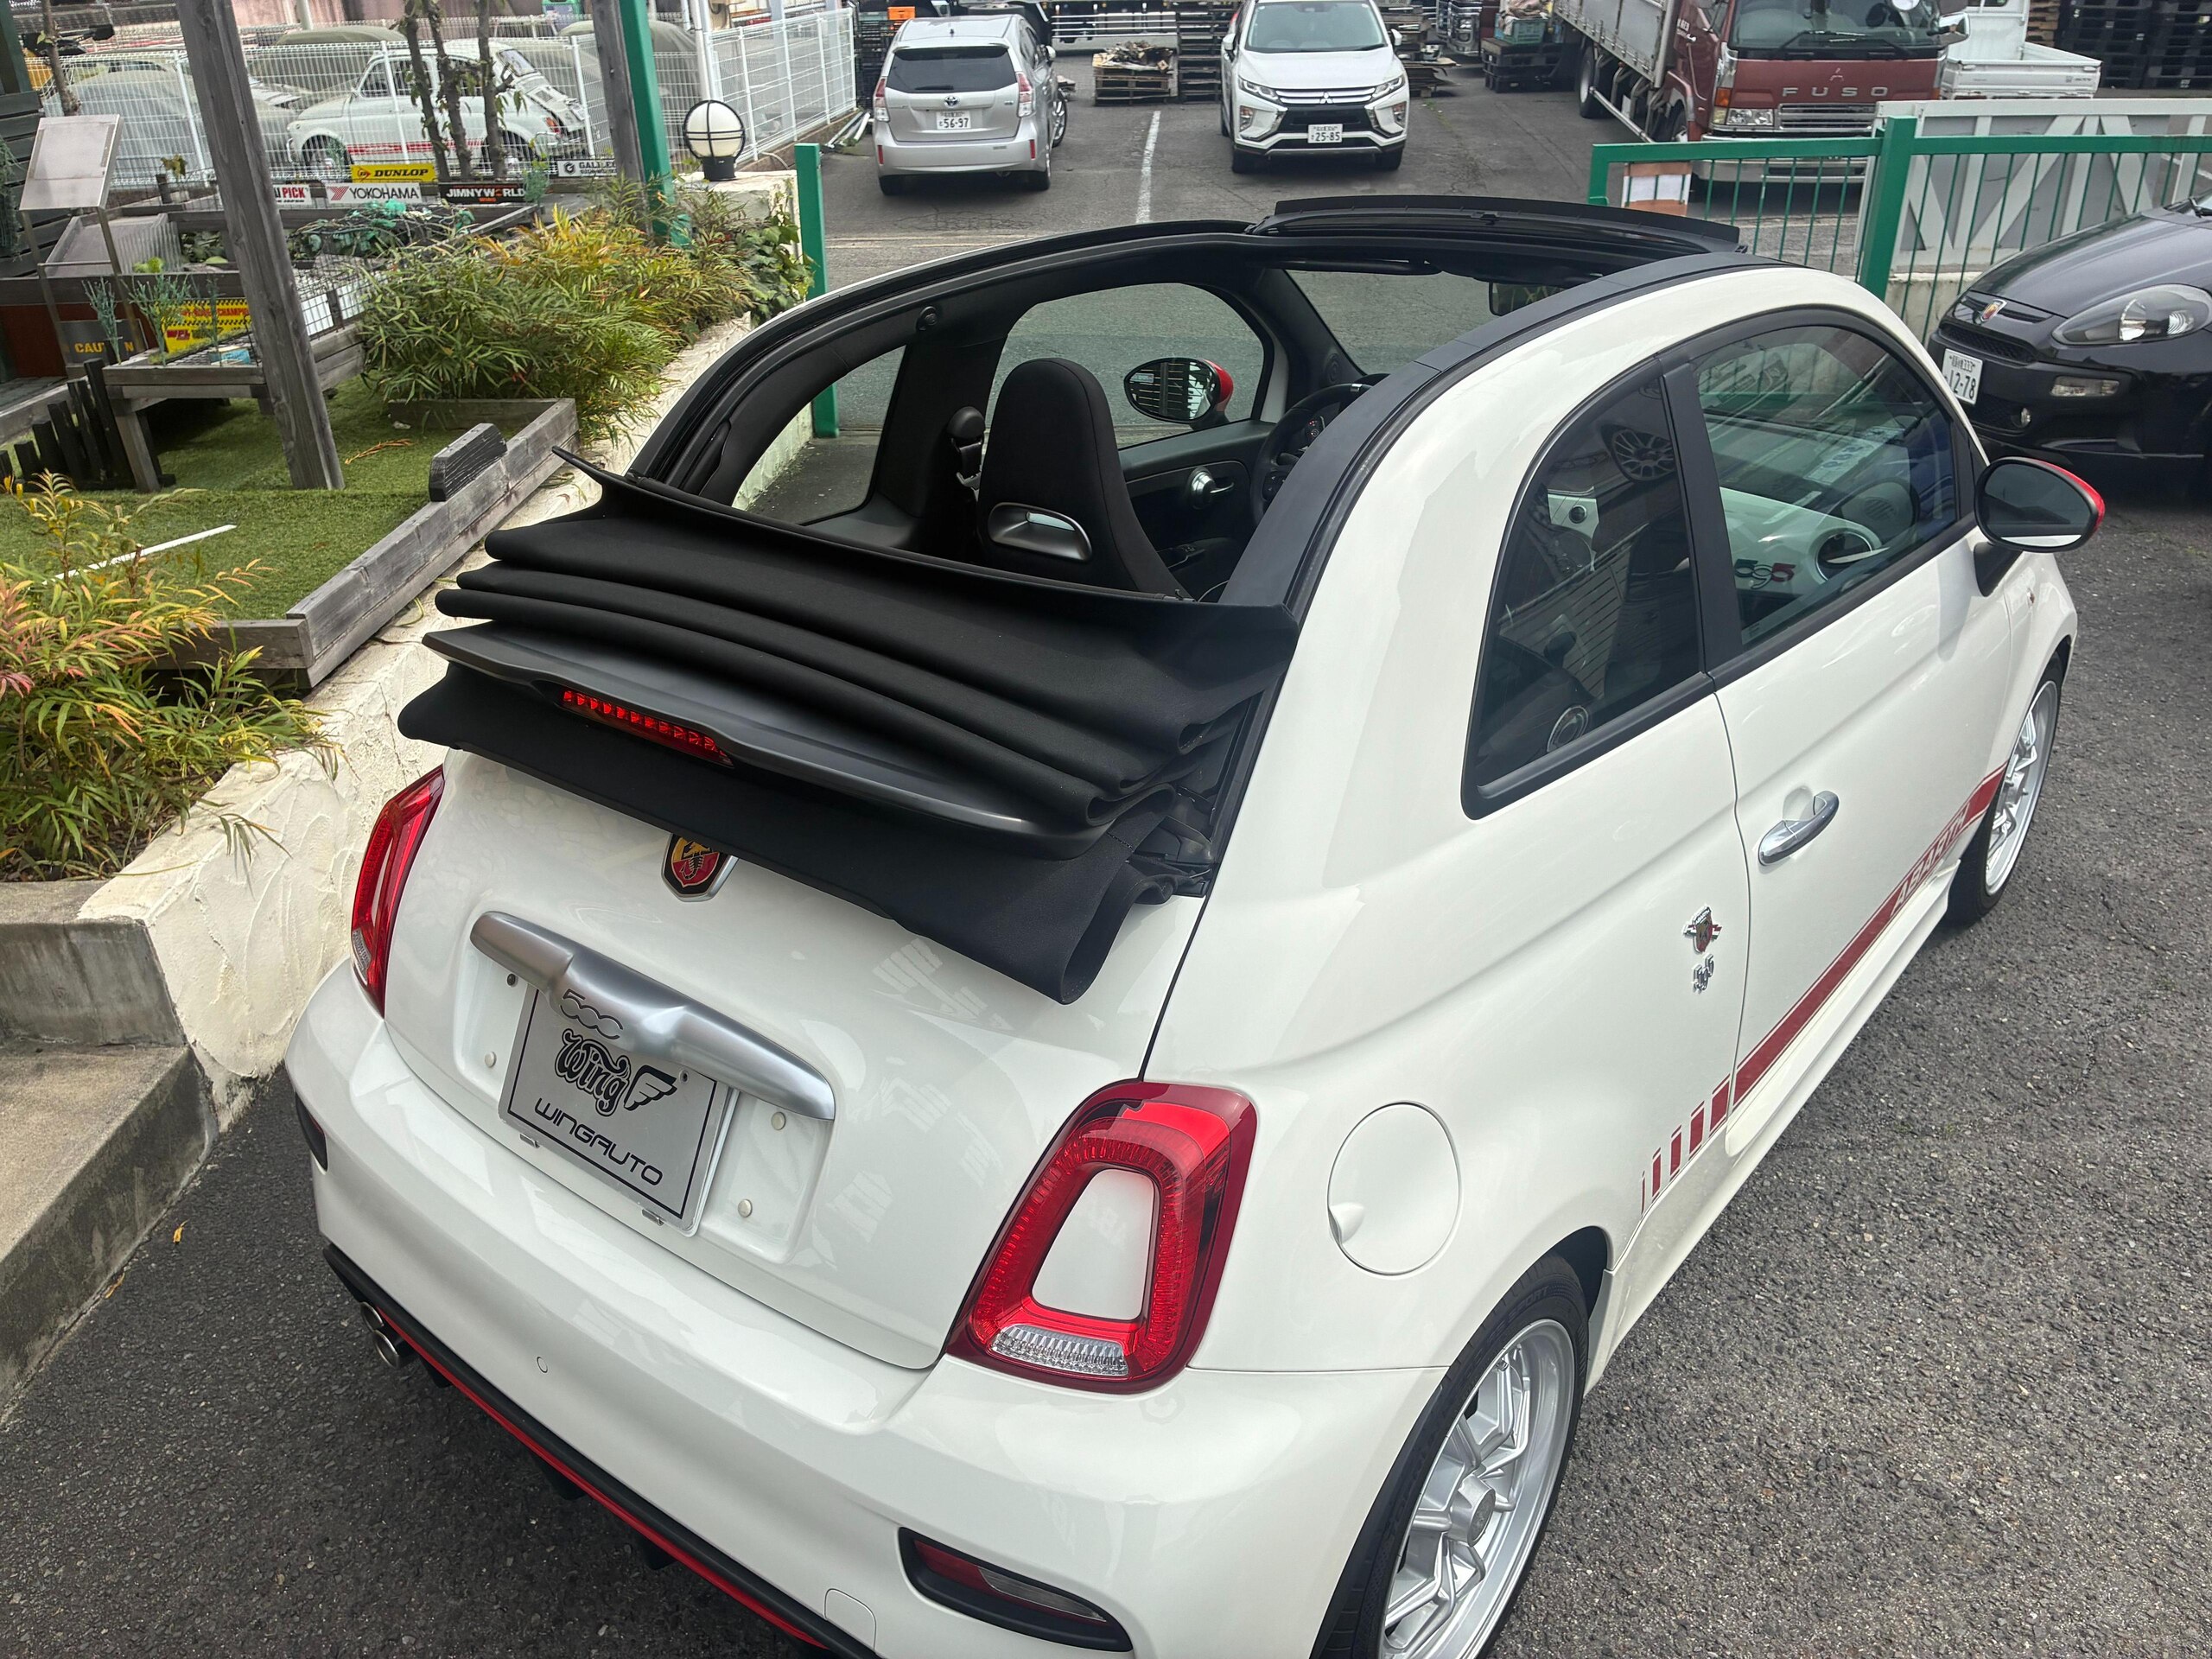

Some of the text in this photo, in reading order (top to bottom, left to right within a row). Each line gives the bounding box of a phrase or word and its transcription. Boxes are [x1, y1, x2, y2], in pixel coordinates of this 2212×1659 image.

[1782, 86, 1888, 97] FUSO
[944, 118, 969, 128] 56-97
[1315, 131, 1340, 142] 25-85
[374, 168, 429, 177] DUNLOP
[282, 187, 306, 199] PICK
[349, 187, 420, 200] YOKOHAMA
[1734, 559, 1796, 589] 595
[1891, 803, 1970, 916] ABARTH
[560, 988, 624, 1039] 500
[534, 1097, 664, 1185] WINGAUTO
